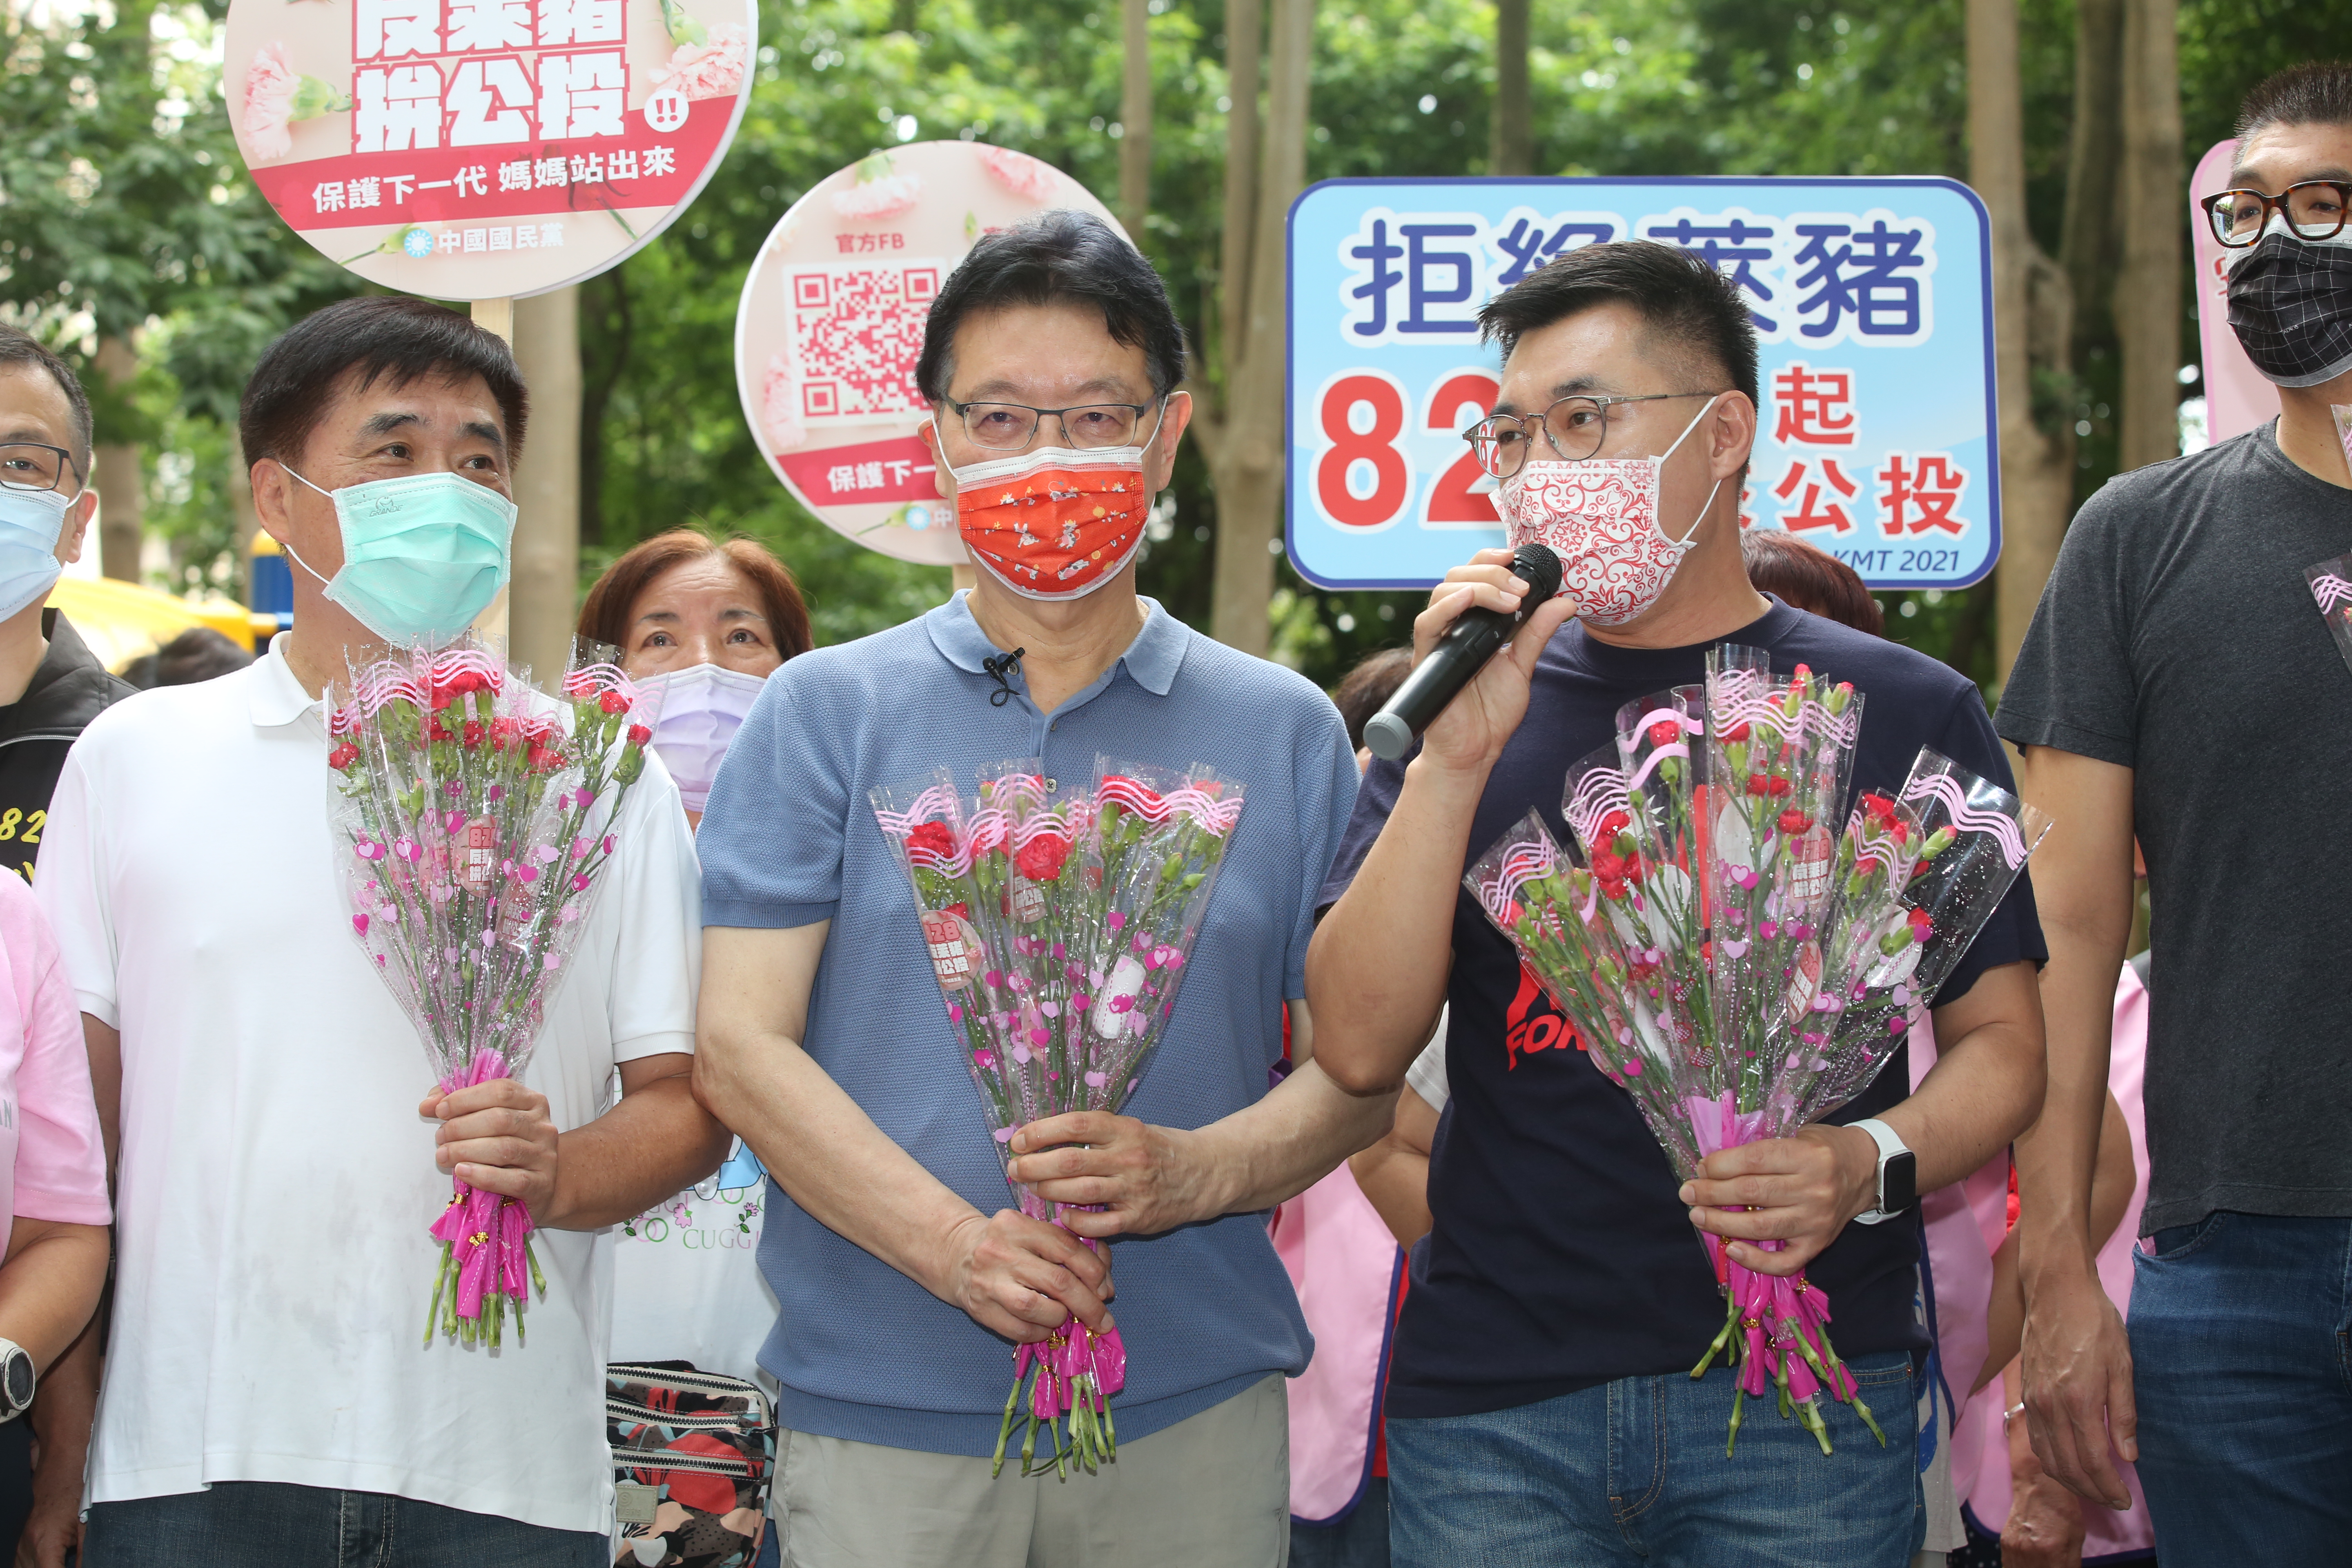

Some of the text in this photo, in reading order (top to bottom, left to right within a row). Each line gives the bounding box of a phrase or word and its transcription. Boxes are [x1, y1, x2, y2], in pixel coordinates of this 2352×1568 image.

[312, 145, 677, 213] 保護下一代 媽媽站出來
[439, 222, 564, 254] 中國國民黨
[835, 232, 904, 254] 官方FB
[369, 505, 403, 517] GRANDE
[1900, 550, 1959, 571] 2021
